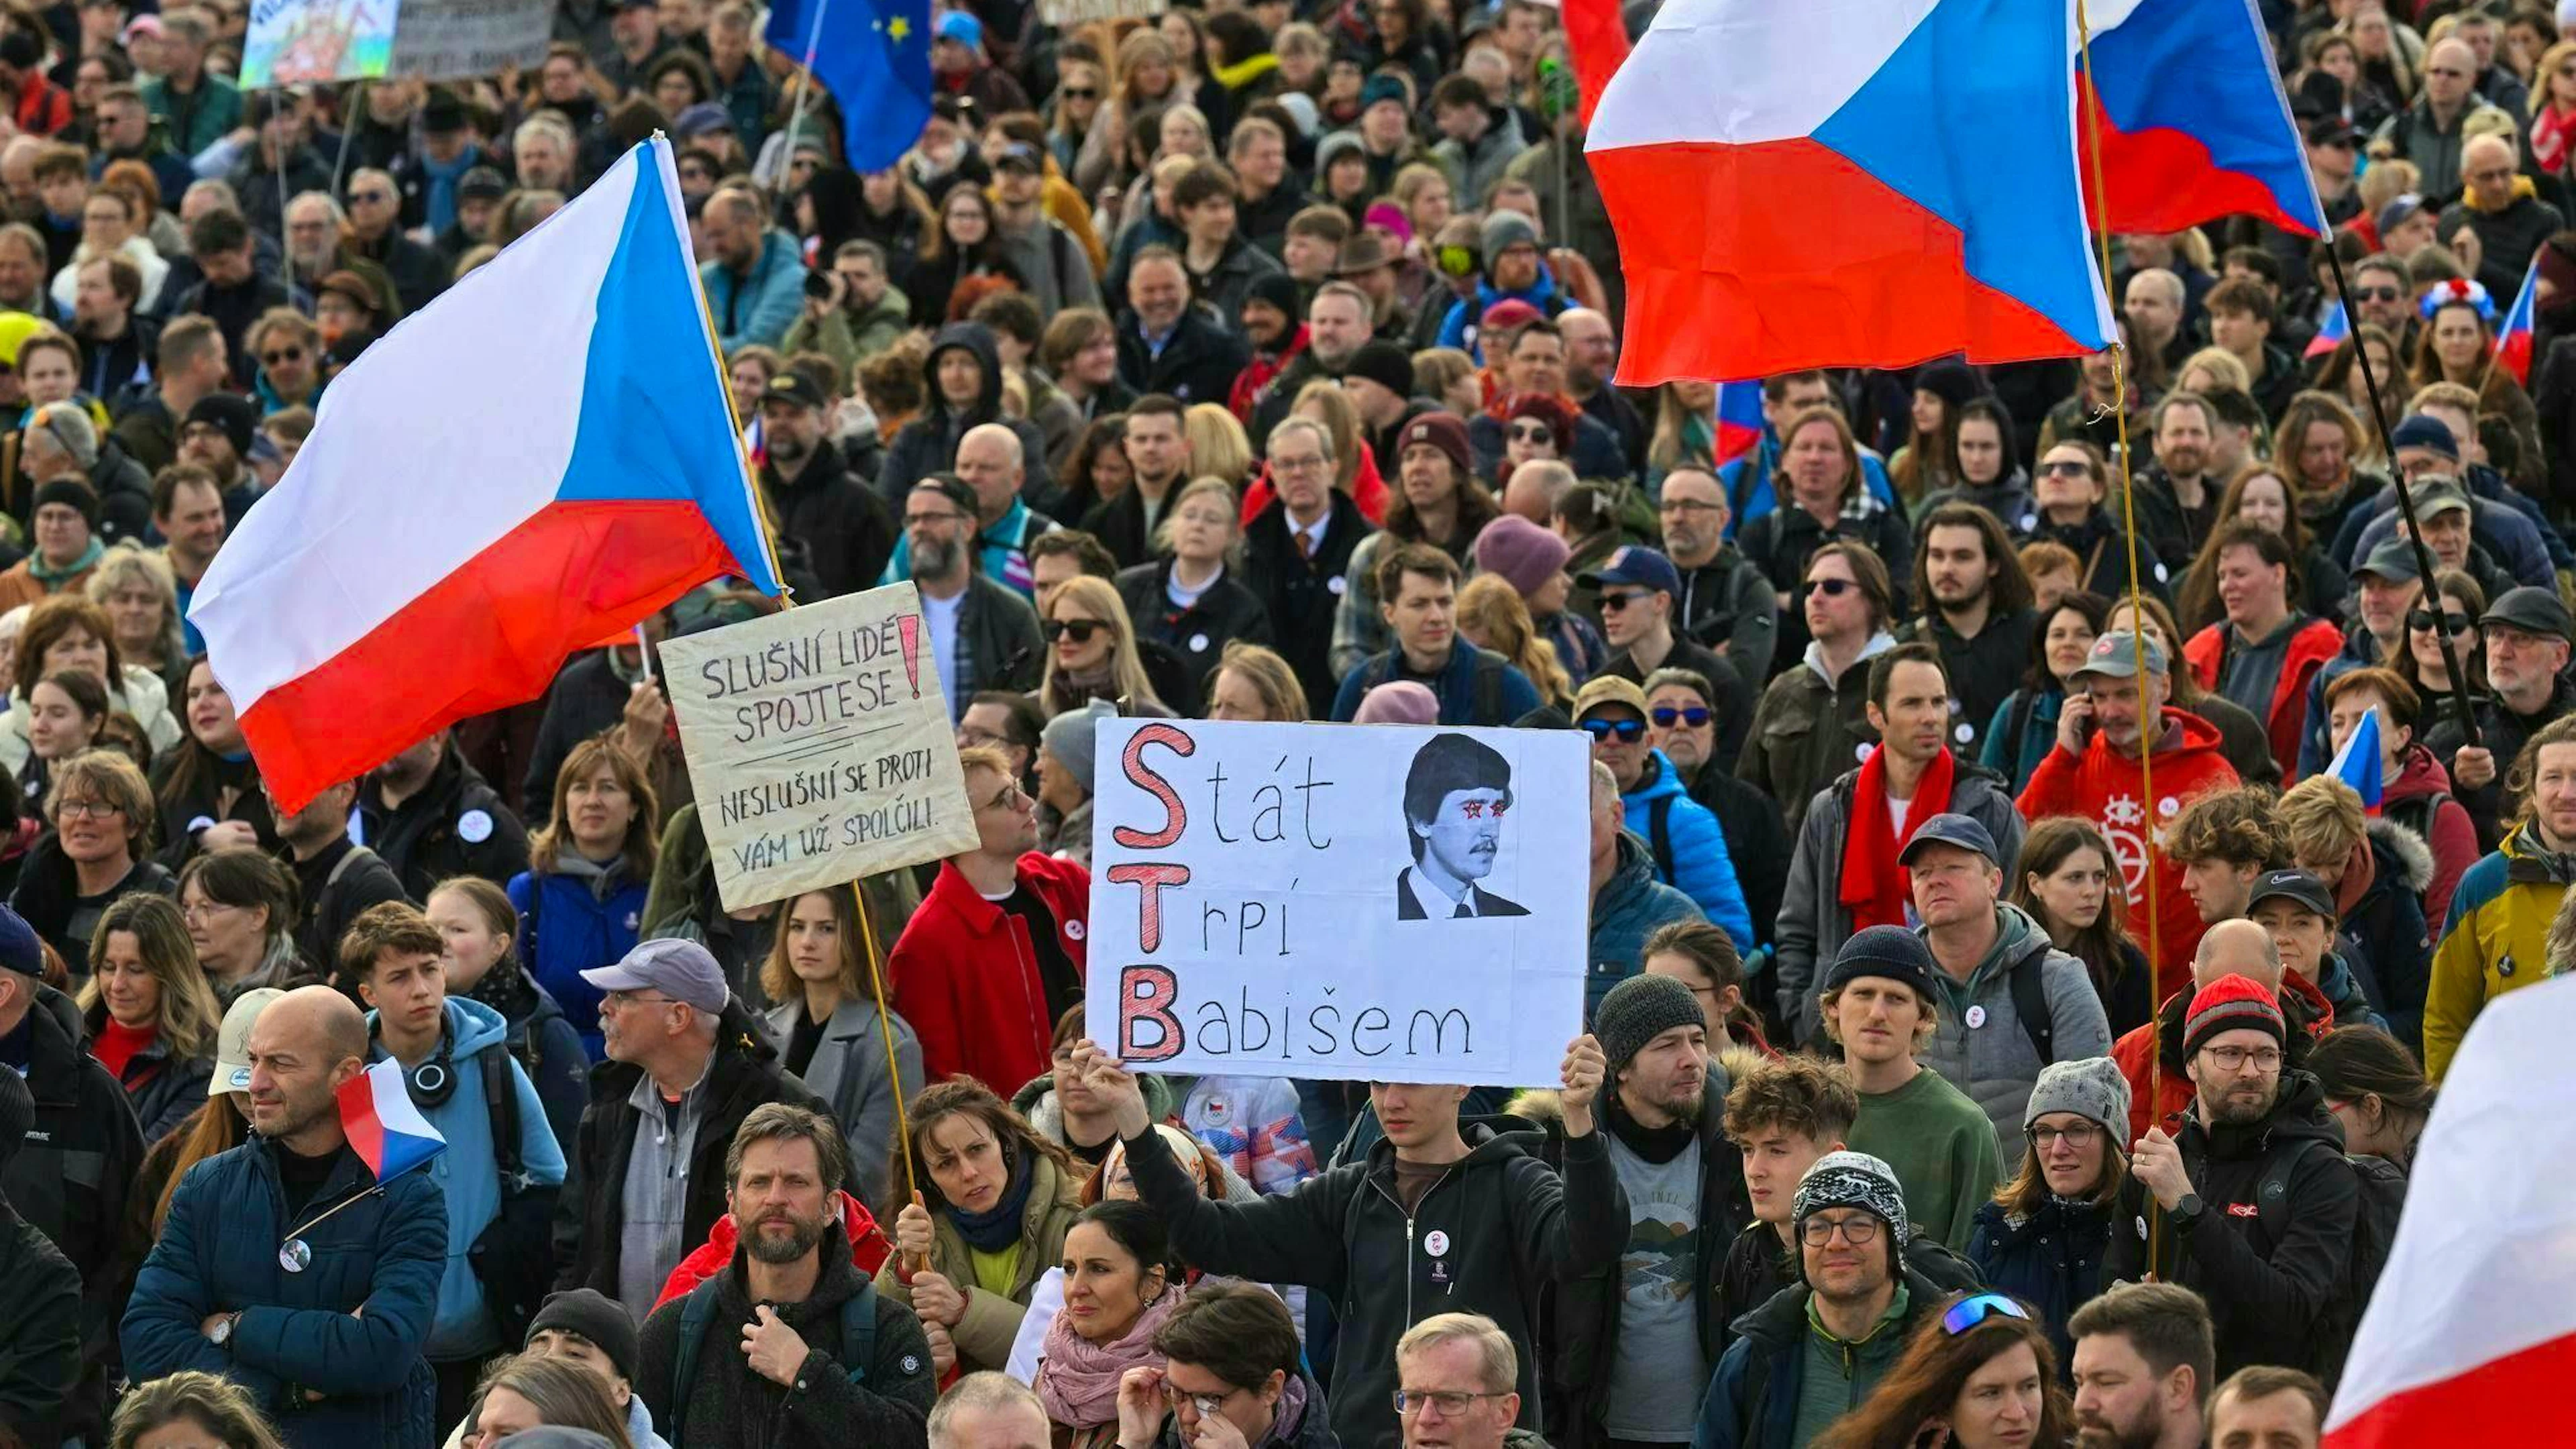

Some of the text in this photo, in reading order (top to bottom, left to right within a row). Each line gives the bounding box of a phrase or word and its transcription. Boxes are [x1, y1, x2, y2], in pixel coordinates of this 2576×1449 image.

[702, 629, 825, 699] SLUŠNÍ
[720, 748, 931, 826] NESLUŠNÍ SE PROTI
[1113, 723, 1334, 849] Stát
[733, 794, 938, 872] VÁM UŽ SPOLČILI.
[1107, 862, 1299, 956] Trpí
[1118, 965, 1473, 1063] Babišem
